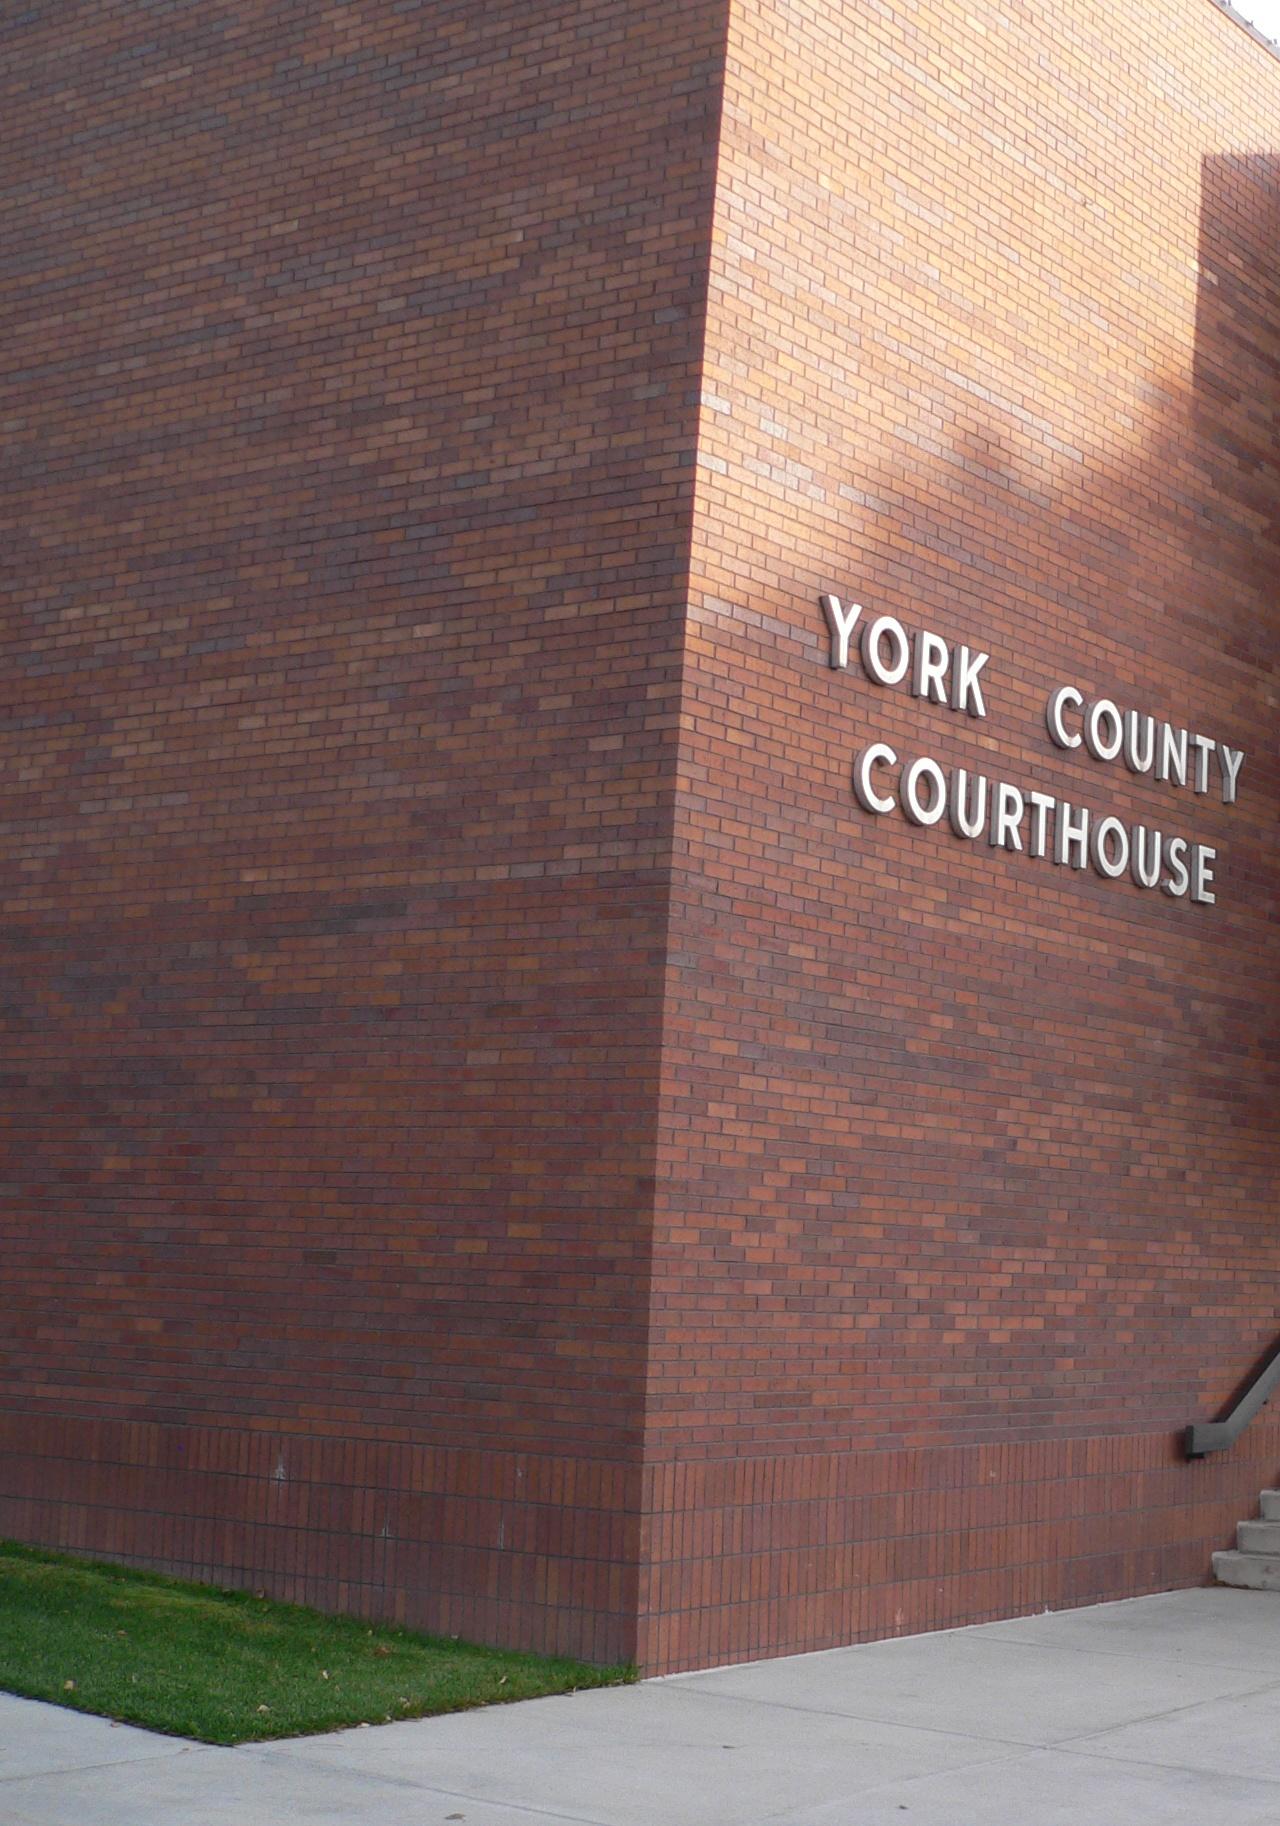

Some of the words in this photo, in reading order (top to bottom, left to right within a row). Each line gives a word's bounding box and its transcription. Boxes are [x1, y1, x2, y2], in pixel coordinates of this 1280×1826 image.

[820, 594, 990, 718] YORK
[1047, 686, 1245, 803] COUNTY
[853, 743, 1216, 904] COURTHOUSE
